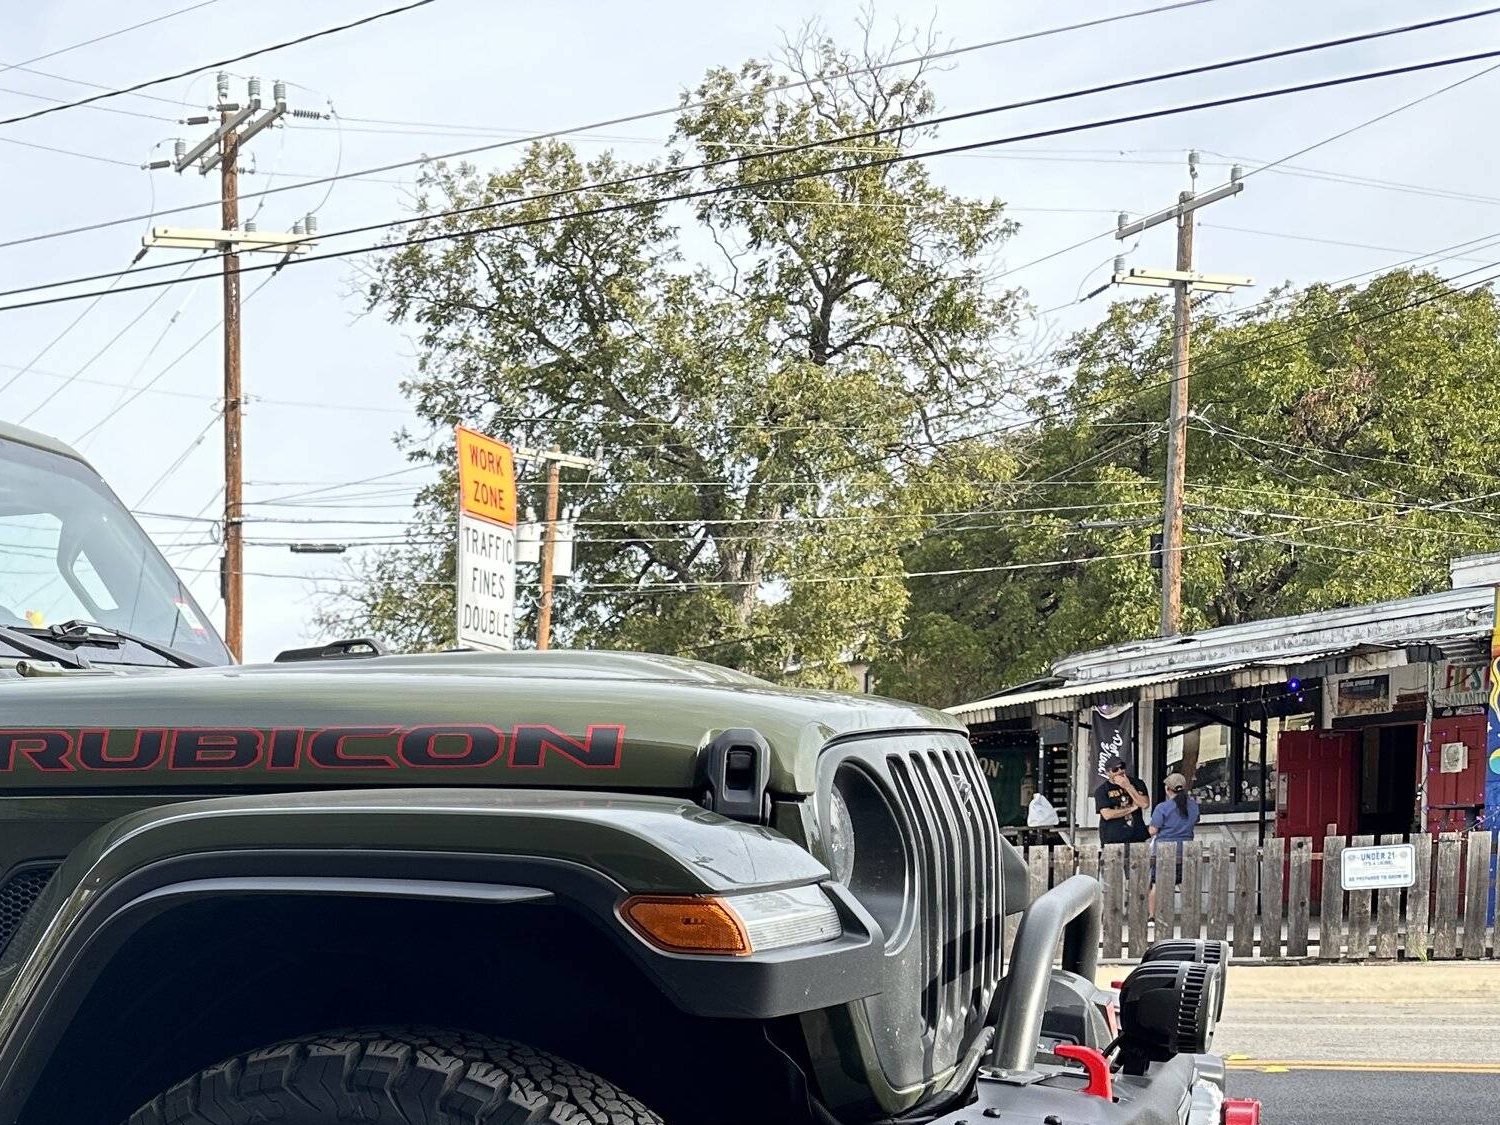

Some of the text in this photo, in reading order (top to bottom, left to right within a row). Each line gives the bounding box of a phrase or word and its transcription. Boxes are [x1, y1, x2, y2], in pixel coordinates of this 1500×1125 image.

[469, 443, 504, 477] WORK
[473, 480, 506, 511] ZONE
[464, 526, 513, 565] TRAFFIC
[472, 567, 505, 600] FINES
[463, 604, 509, 639] DOUBLE
[1361, 850, 1395, 861] UNDER 21
